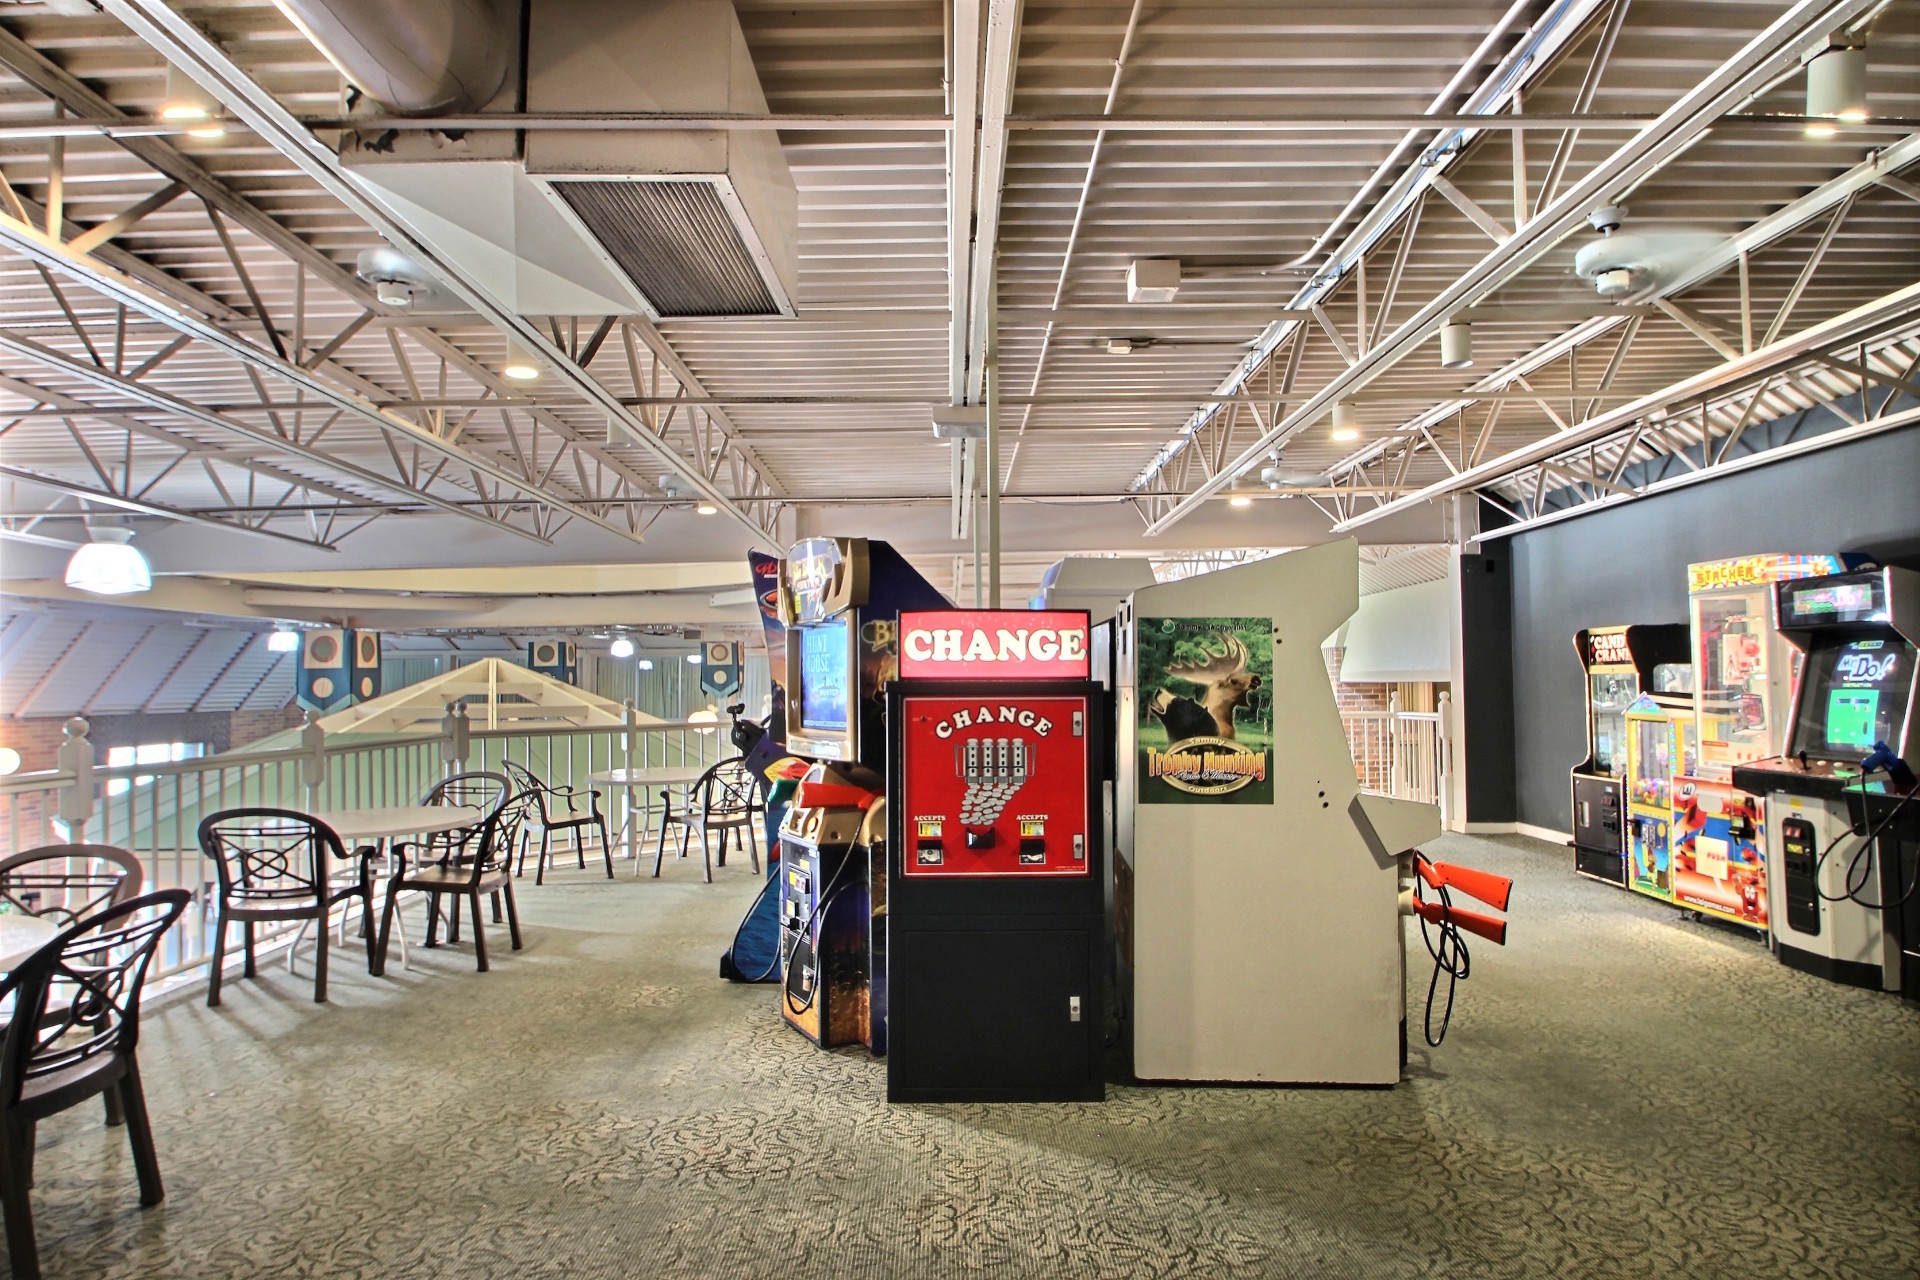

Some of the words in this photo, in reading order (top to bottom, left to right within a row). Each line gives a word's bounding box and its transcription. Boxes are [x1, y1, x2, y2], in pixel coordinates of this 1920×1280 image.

[1696, 564, 1755, 585] STACKER
[806, 633, 828, 653] HUNT
[903, 628, 1087, 662] CHANGE
[1593, 633, 1627, 650] CAND
[935, 705, 1052, 738] CHANGE
[1189, 737, 1226, 746] Sammy
[1147, 746, 1202, 777] Trophy
[1203, 750, 1266, 781] Hunting
[1188, 786, 1228, 794] Outdoors
[1683, 894, 1736, 914] www.laigames.com
